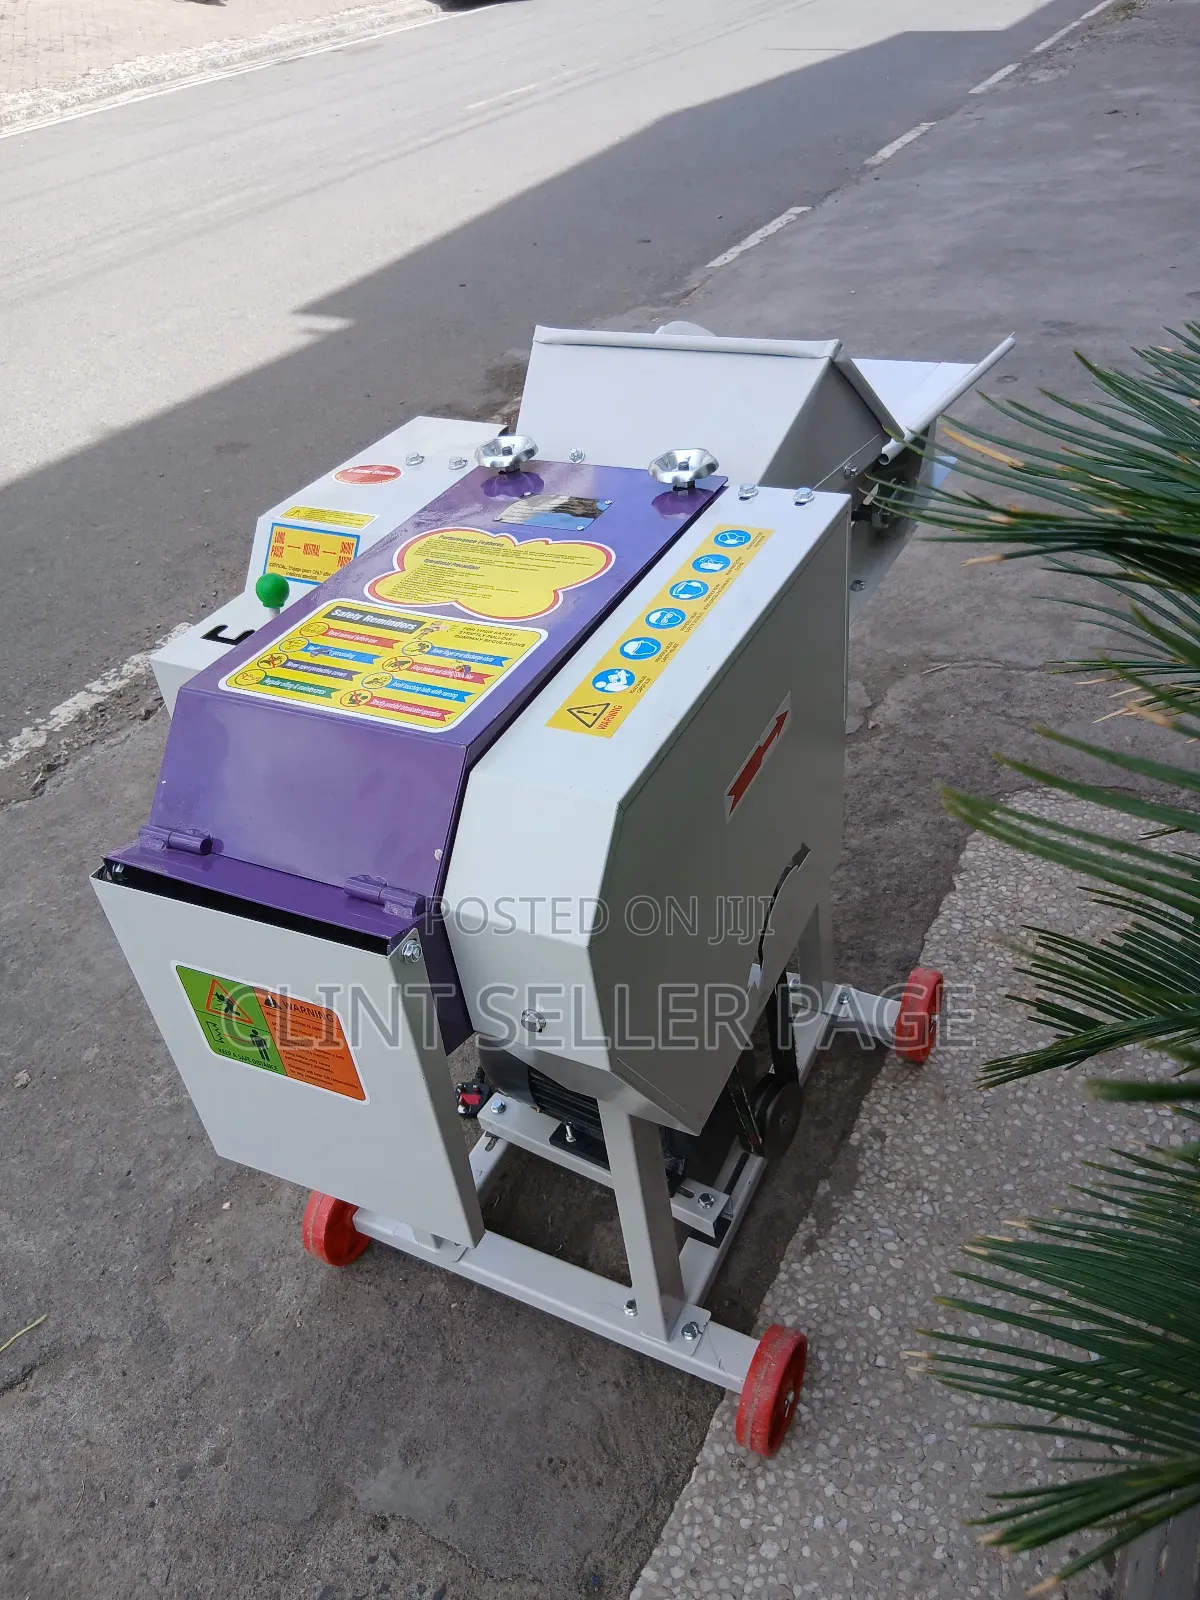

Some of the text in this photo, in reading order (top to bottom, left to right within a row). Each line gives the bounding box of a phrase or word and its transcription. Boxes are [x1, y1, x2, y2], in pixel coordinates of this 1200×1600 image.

[438, 534, 504, 547] Performance Features
[331, 608, 417, 630] Safety Reminders
[454, 634, 526, 647] COMPANY REGULATIONS
[596, 705, 623, 730] WARNING
[283, 1000, 334, 1023] WARNING
[251, 1059, 279, 1071] DISTANCE
